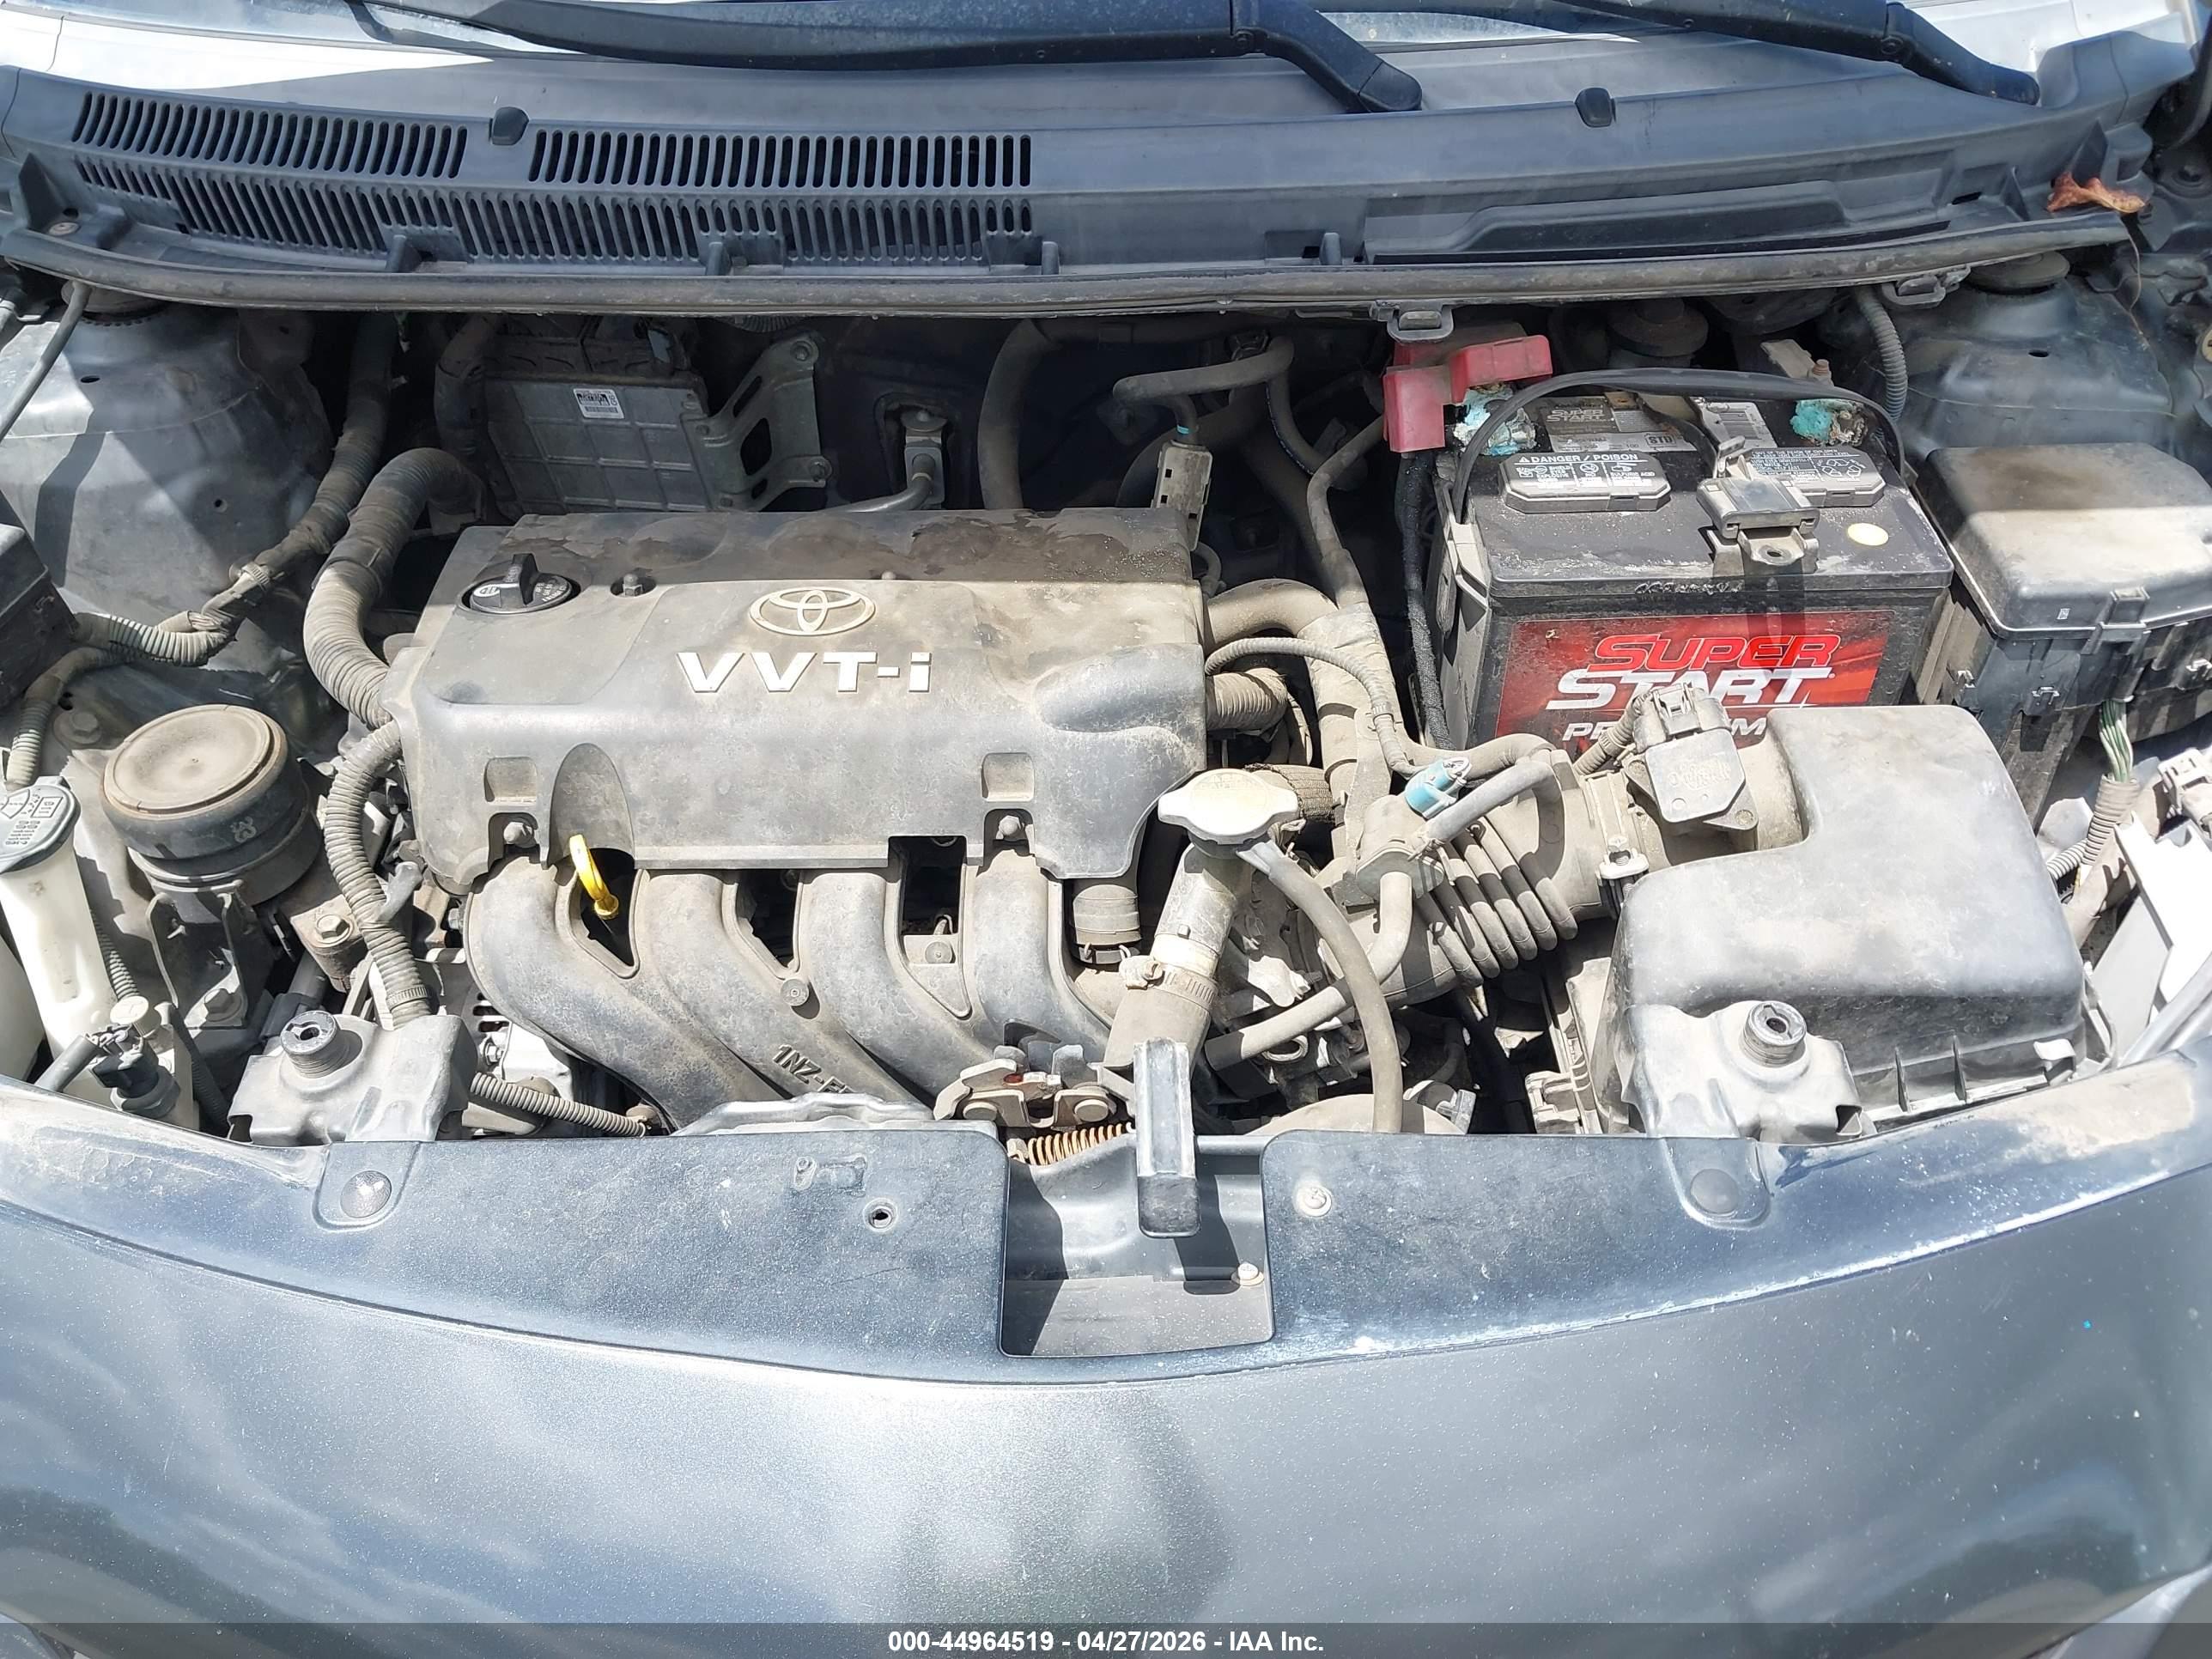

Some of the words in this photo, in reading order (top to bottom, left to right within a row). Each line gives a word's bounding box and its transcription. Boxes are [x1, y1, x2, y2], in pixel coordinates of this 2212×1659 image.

[677, 652, 932, 693] VVT-i
[1587, 634, 1841, 672] SUPER
[773, 1044, 857, 1093] 1NZ-F
